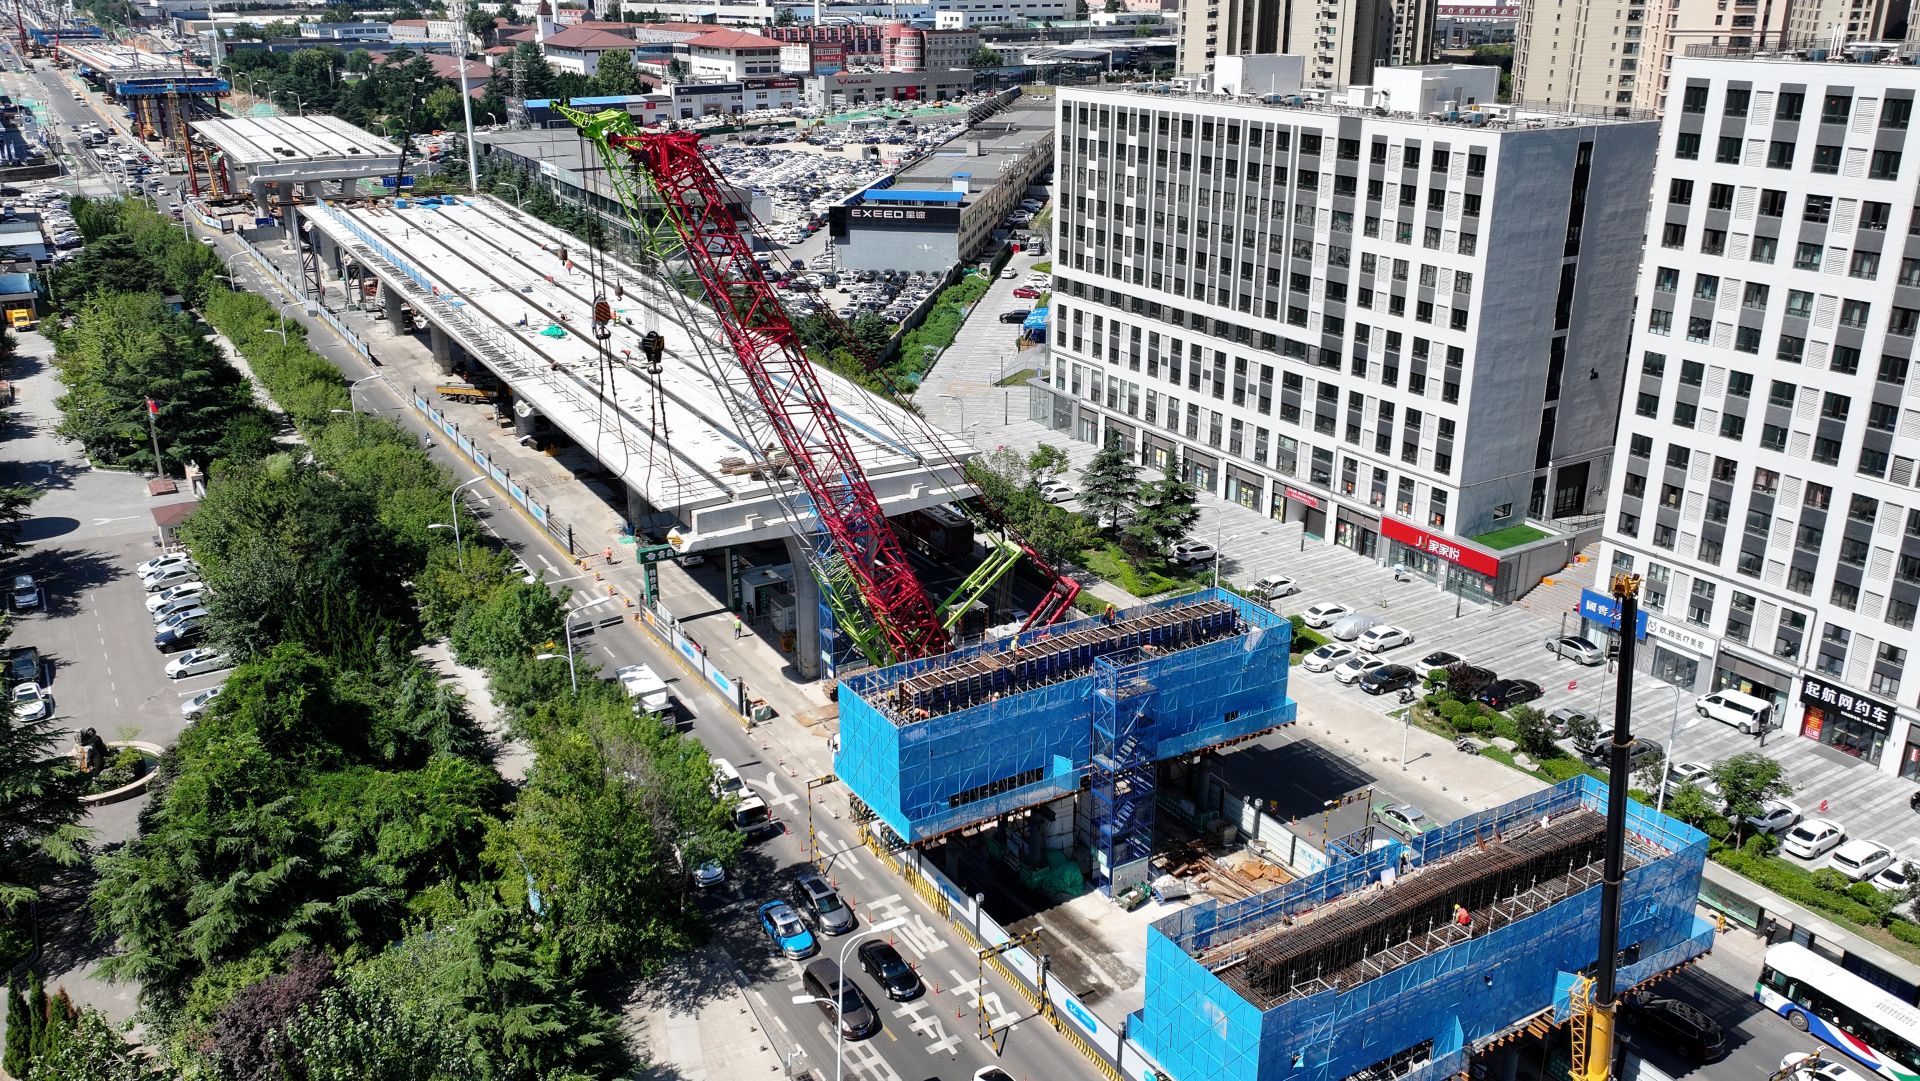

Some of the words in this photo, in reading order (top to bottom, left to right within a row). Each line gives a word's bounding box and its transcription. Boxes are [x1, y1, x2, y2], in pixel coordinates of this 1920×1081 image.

[851, 209, 904, 219] EXEED
[905, 210, 926, 219] 星途
[1428, 539, 1461, 562] 家家悦
[1804, 680, 1890, 723] 起航网约车
